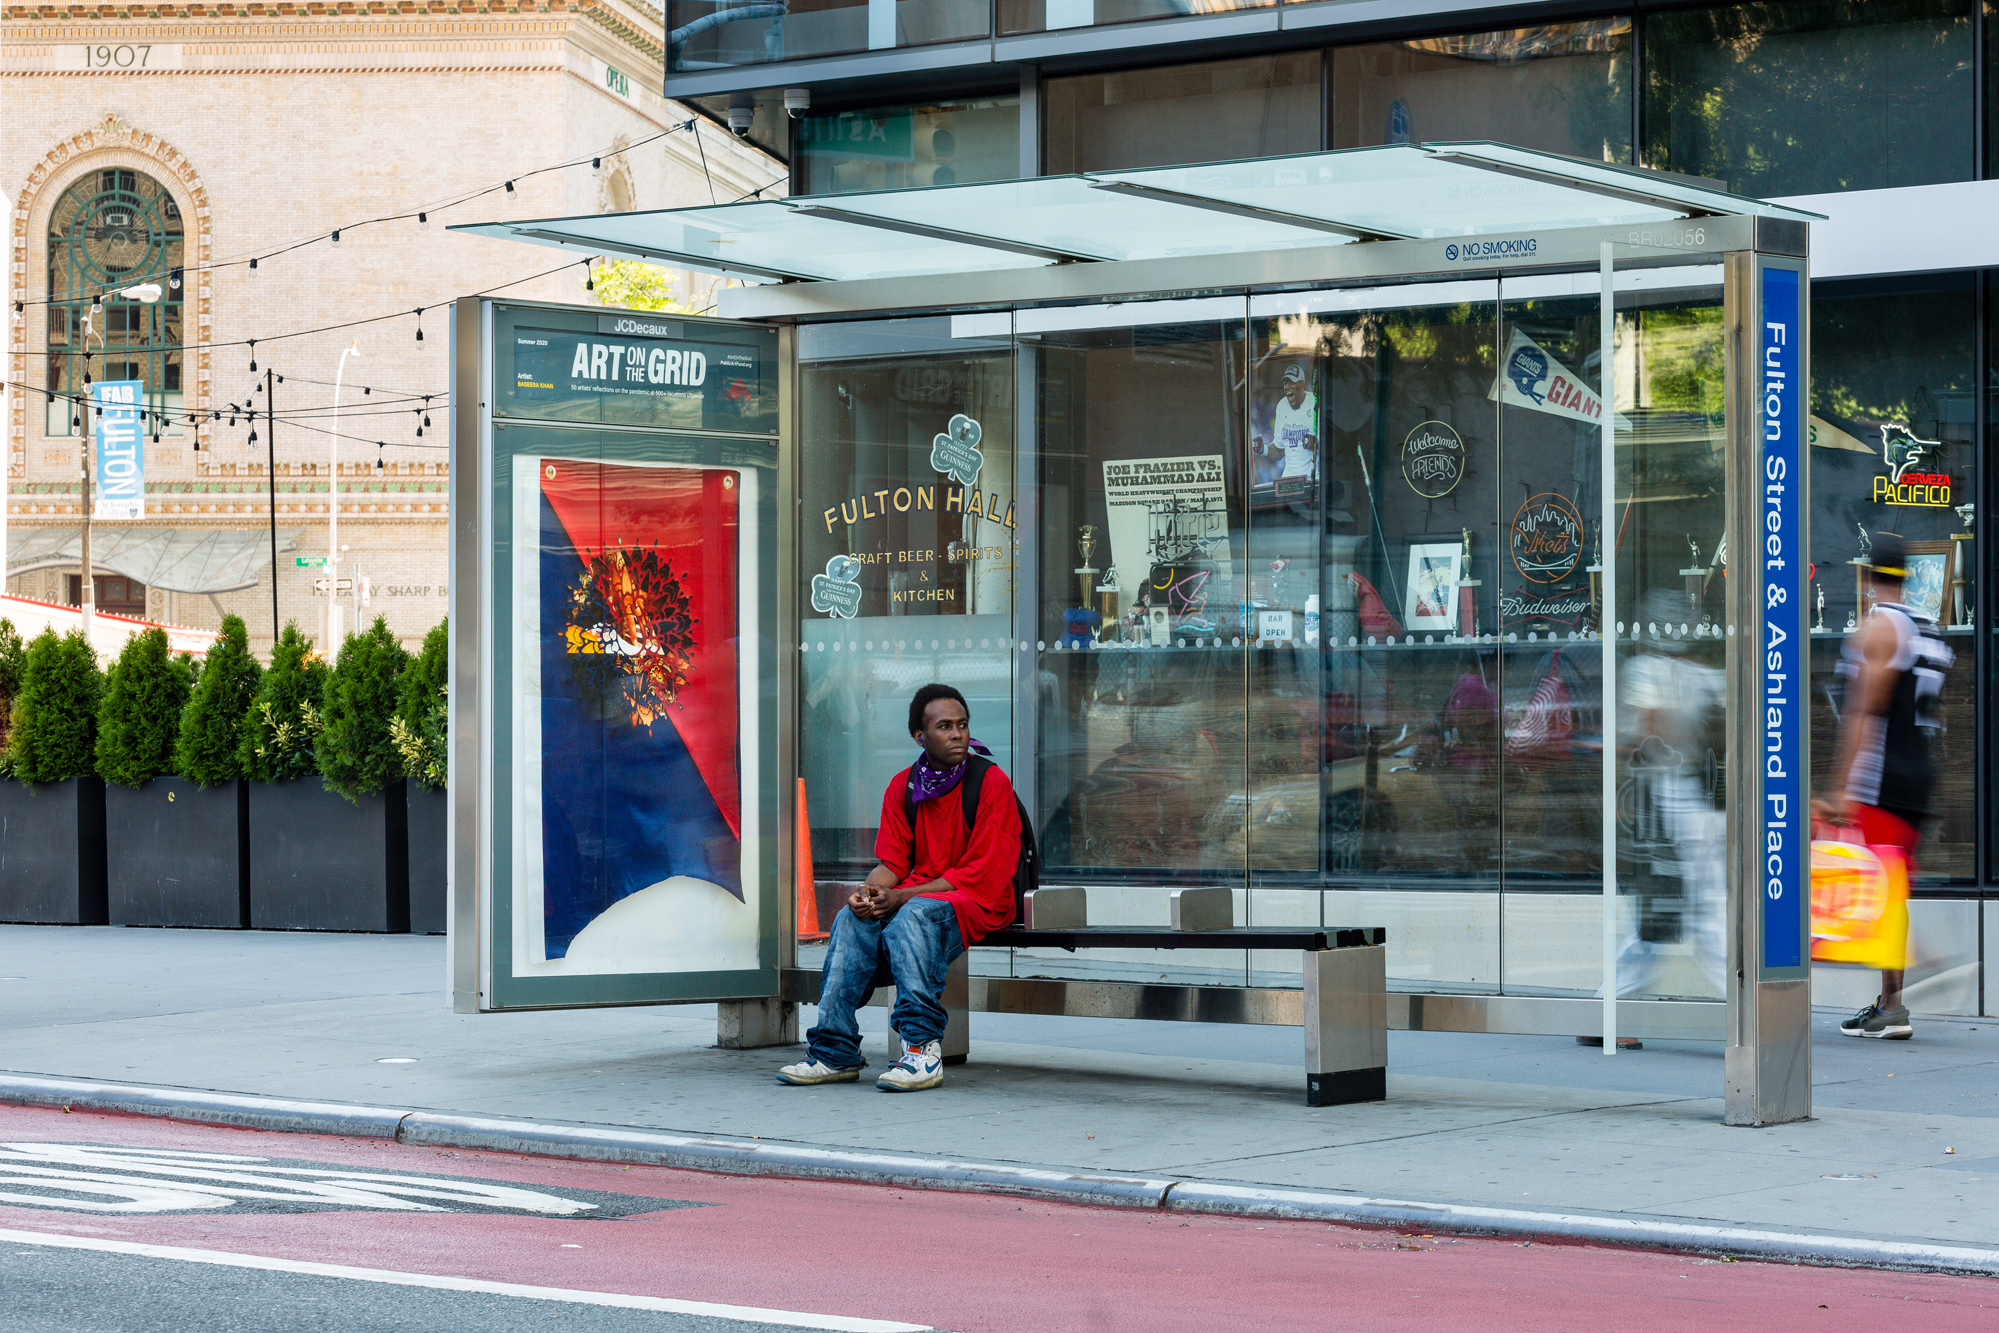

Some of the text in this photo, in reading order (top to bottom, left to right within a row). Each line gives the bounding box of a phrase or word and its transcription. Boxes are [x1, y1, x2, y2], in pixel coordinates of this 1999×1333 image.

[85, 45, 152, 67] 1907
[606, 66, 629, 98] OPERA
[1628, 227, 1705, 248] BR02056
[1463, 238, 1537, 256] NO SMOKING
[614, 319, 668, 336] JCDecaux
[517, 338, 536, 346] Summer
[571, 342, 707, 387] ART ON THE GRID
[1516, 353, 1543, 375] GIANTS
[517, 372, 534, 380] Artist:
[517, 381, 540, 389] BASEERA
[101, 385, 134, 405] FAB
[592, 385, 614, 393] reflections
[1547, 375, 1602, 419] GIANT
[103, 404, 136, 495] FULTON
[1408, 432, 1459, 454] Welcome
[940, 450, 972, 472] GUINNESS
[947, 444, 968, 457] PATRICK'S
[968, 453, 977, 462] DAY
[1106, 459, 1221, 476] JOE FRAZIER VS.
[1411, 454, 1457, 479] FRIENDS
[1106, 471, 1222, 487] MUHAMMAD ALI
[1900, 472, 1951, 486] CERVEZA
[823, 484, 1016, 535] FULTON HALL
[1524, 529, 1570, 554] Mets
[849, 552, 892, 565] CRAFT
[898, 550, 934, 563] BEER
[947, 546, 1003, 561] SPIRITS
[831, 578, 846, 586] HAPPY
[919, 570, 929, 582] &
[386, 585, 431, 597] SHARP
[825, 582, 847, 592] PATRICK'S
[893, 588, 955, 602] KITCHEN
[820, 590, 852, 606] GUINNESS
[1502, 597, 1591, 616] Budweiser
[1766, 322, 1787, 900] Fulton Street & Ashland Place
